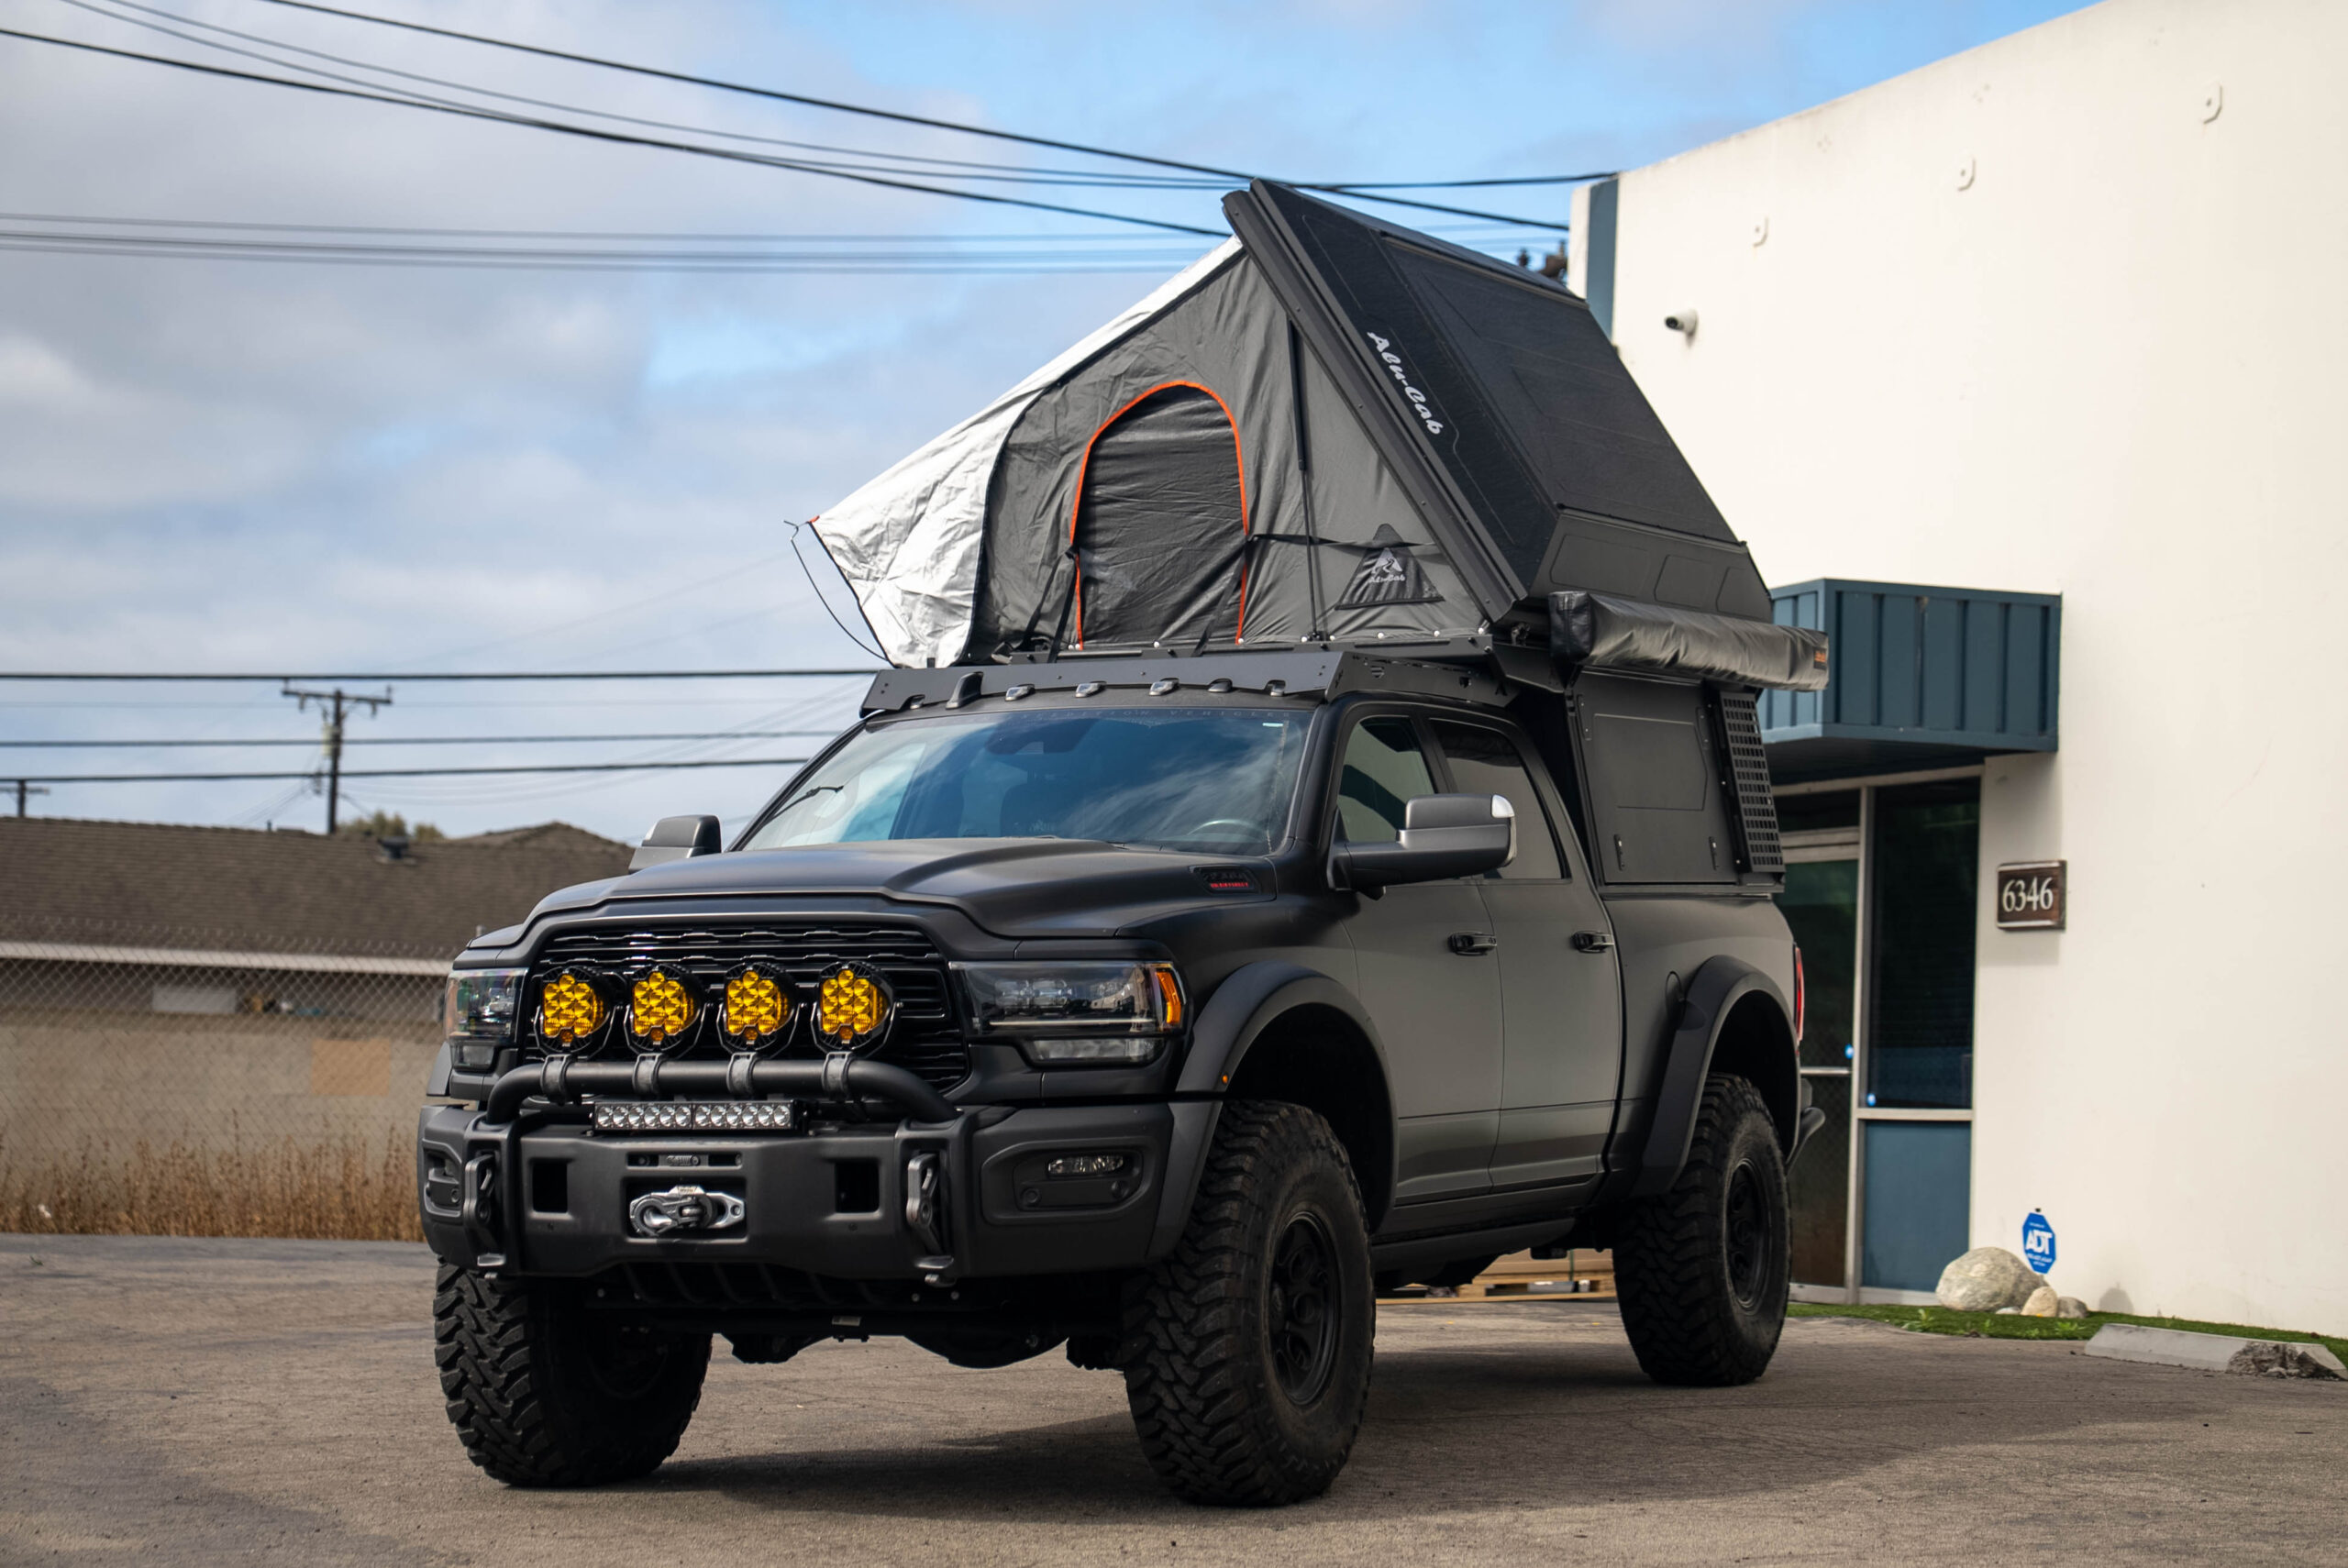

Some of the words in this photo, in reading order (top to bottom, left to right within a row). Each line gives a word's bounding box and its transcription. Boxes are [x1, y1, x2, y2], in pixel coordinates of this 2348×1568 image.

[1367, 331, 1444, 435] Alu-Cab
[2002, 877, 2054, 912] 6346
[2025, 1229, 2053, 1255] ADT
